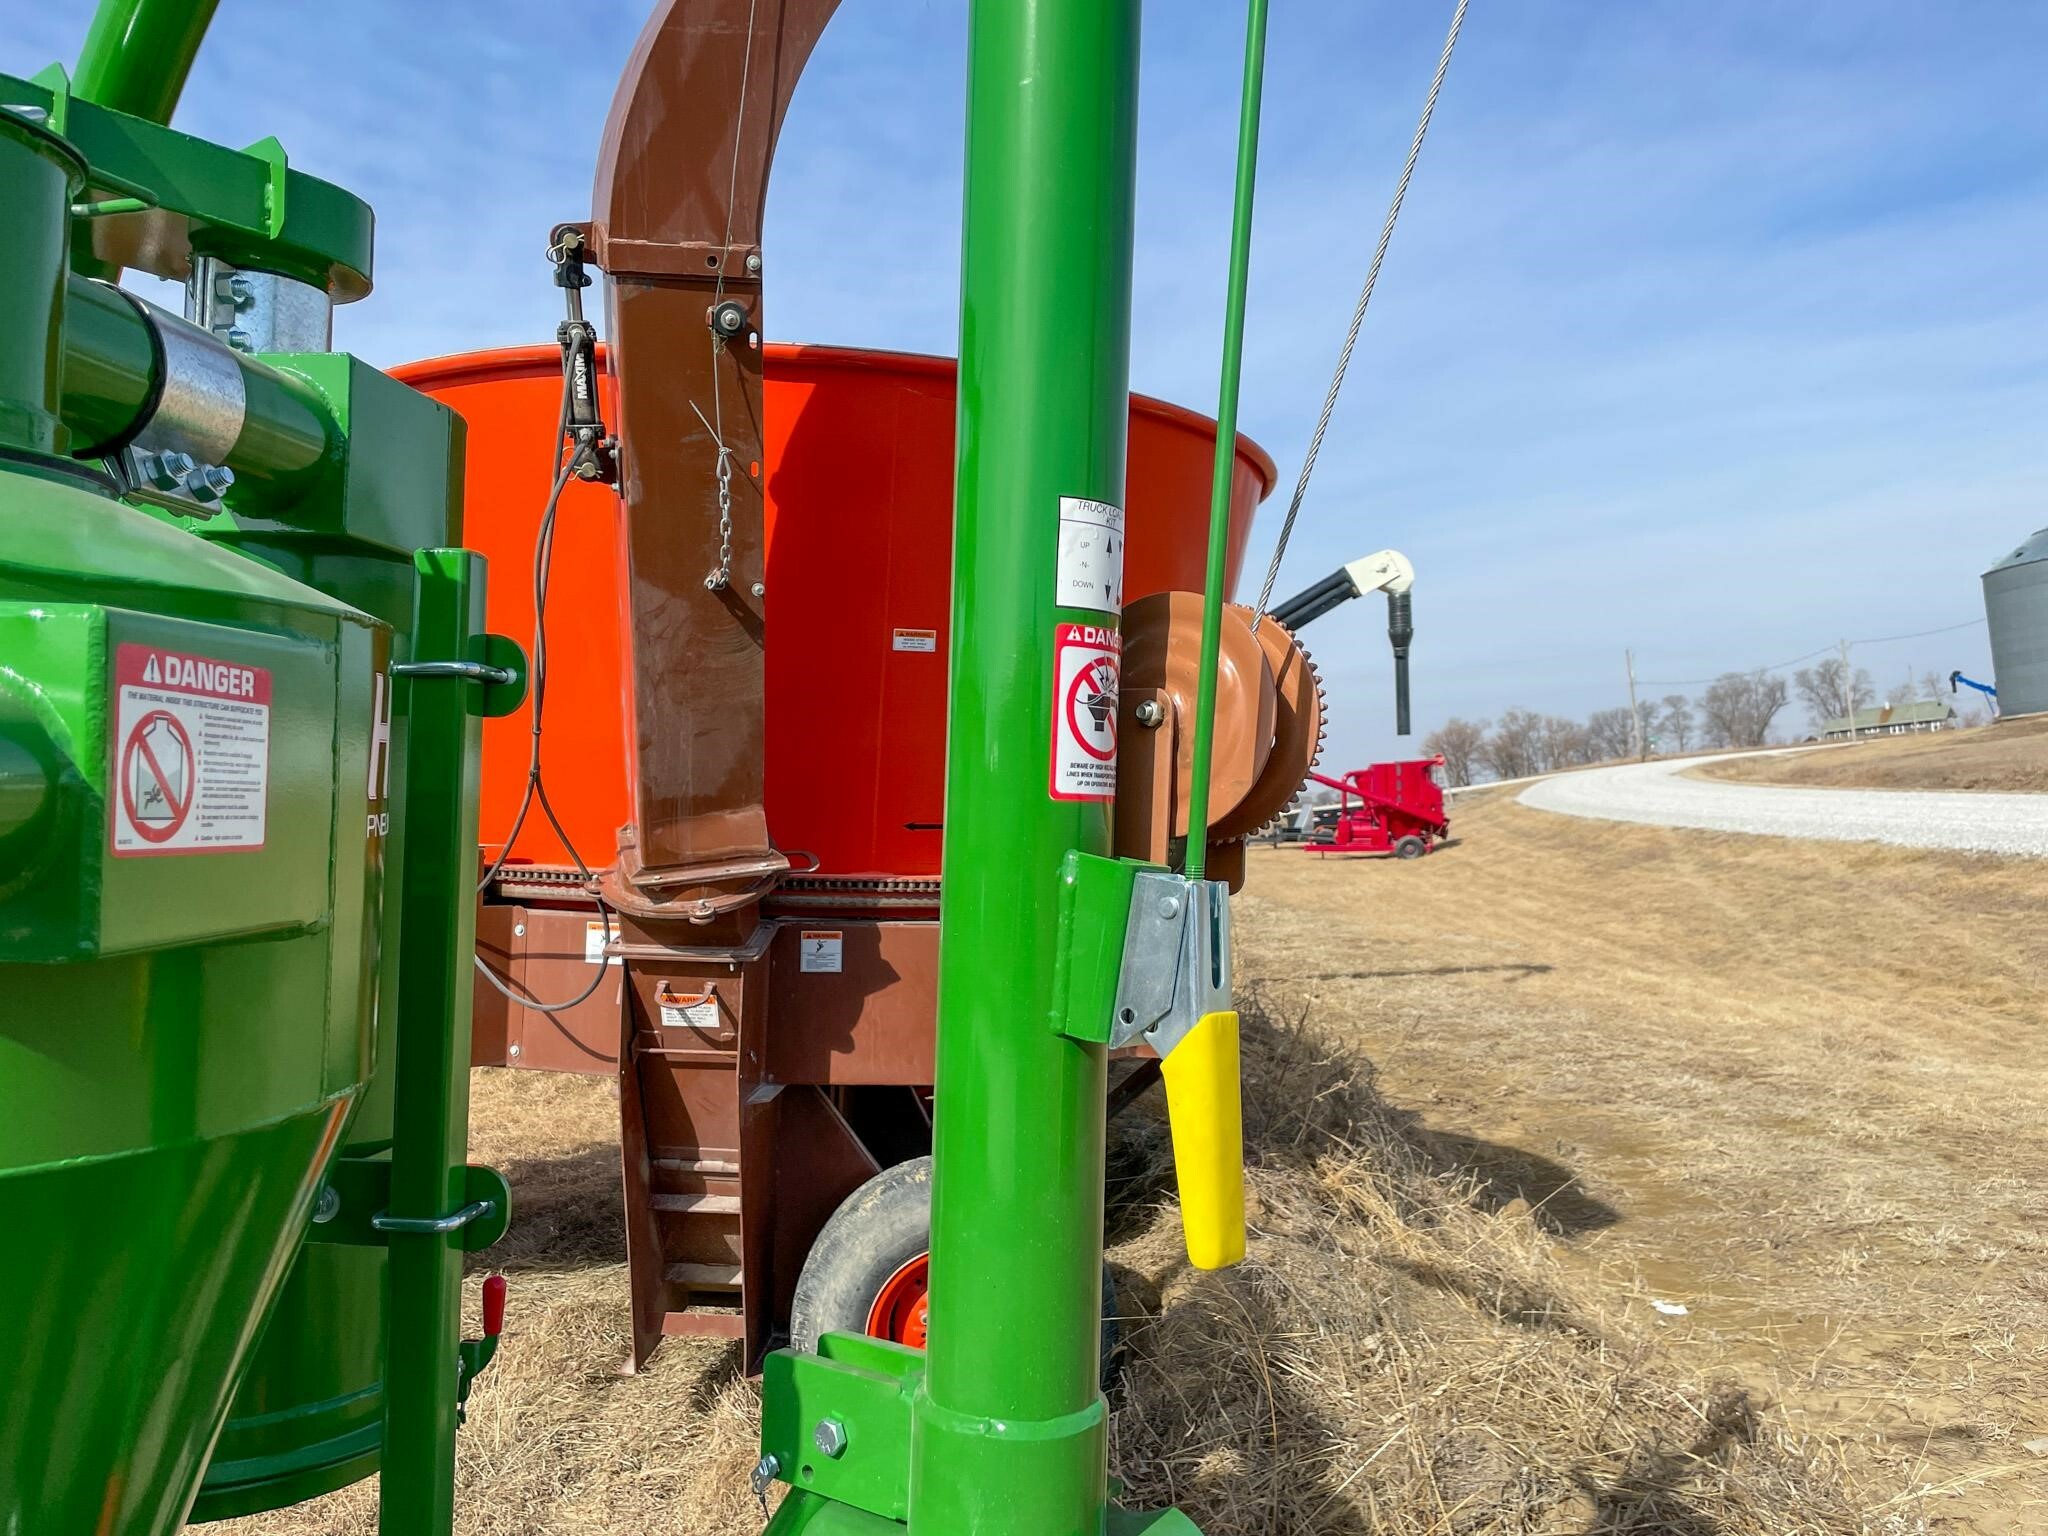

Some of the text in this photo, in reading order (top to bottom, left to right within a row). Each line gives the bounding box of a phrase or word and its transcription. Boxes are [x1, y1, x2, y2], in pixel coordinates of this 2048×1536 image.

[574, 352, 588, 399] MAXIM
[1078, 500, 1122, 521] TRUCK LOA
[1106, 517, 1116, 529] KIT
[1080, 540, 1090, 548] UP
[1072, 579, 1094, 589] DOWN
[165, 655, 255, 698] DANGER
